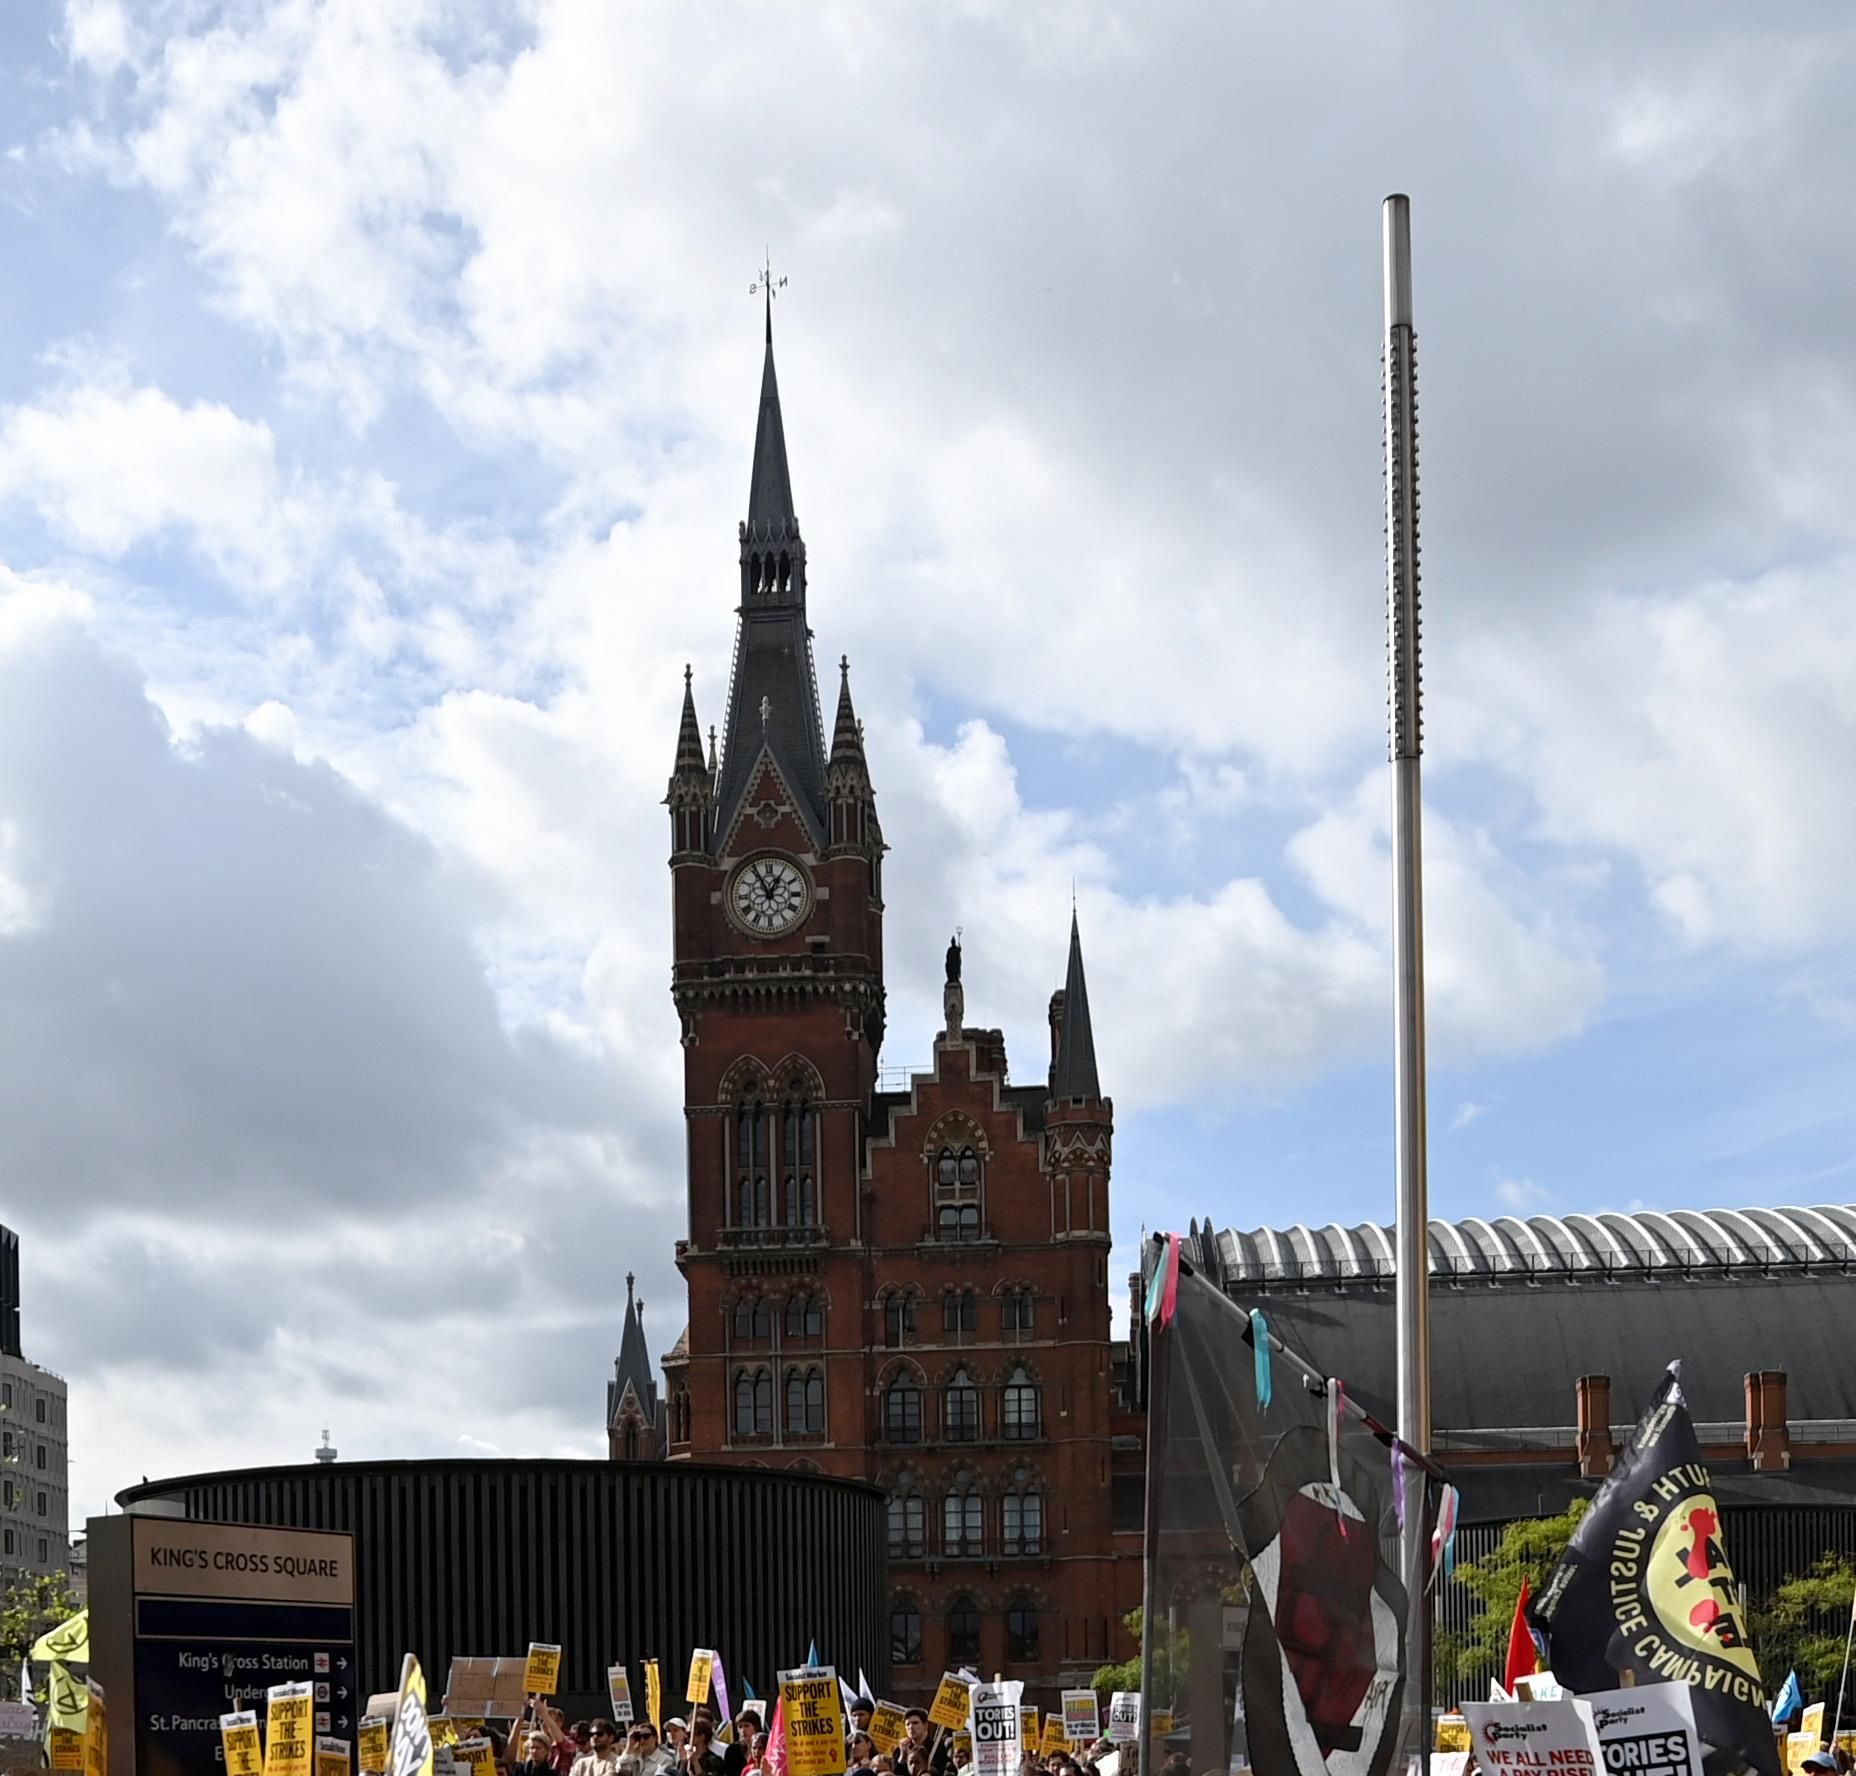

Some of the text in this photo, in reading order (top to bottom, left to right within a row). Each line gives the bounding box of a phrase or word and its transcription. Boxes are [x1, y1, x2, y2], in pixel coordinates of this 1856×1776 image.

[150, 1546, 339, 1578] KING'S CROSS SQUARE
[178, 1651, 219, 1672] King's
[261, 1653, 309, 1671] Station
[784, 1681, 832, 1702] SUPPORT
[271, 1699, 309, 1722] SUPPORT
[798, 1701, 820, 1719] THE
[976, 1707, 1015, 1721] TORIES
[1601, 1706, 1646, 1720] Socialist
[150, 1714, 170, 1731] St.
[279, 1720, 297, 1740] THE
[790, 1718, 834, 1737] STRIKES
[977, 1721, 1015, 1740] OUT!
[1493, 1721, 1548, 1736] Socialist
[271, 1739, 306, 1762] STRIKES
[1485, 1749, 1595, 1767] WE ALL NEED
